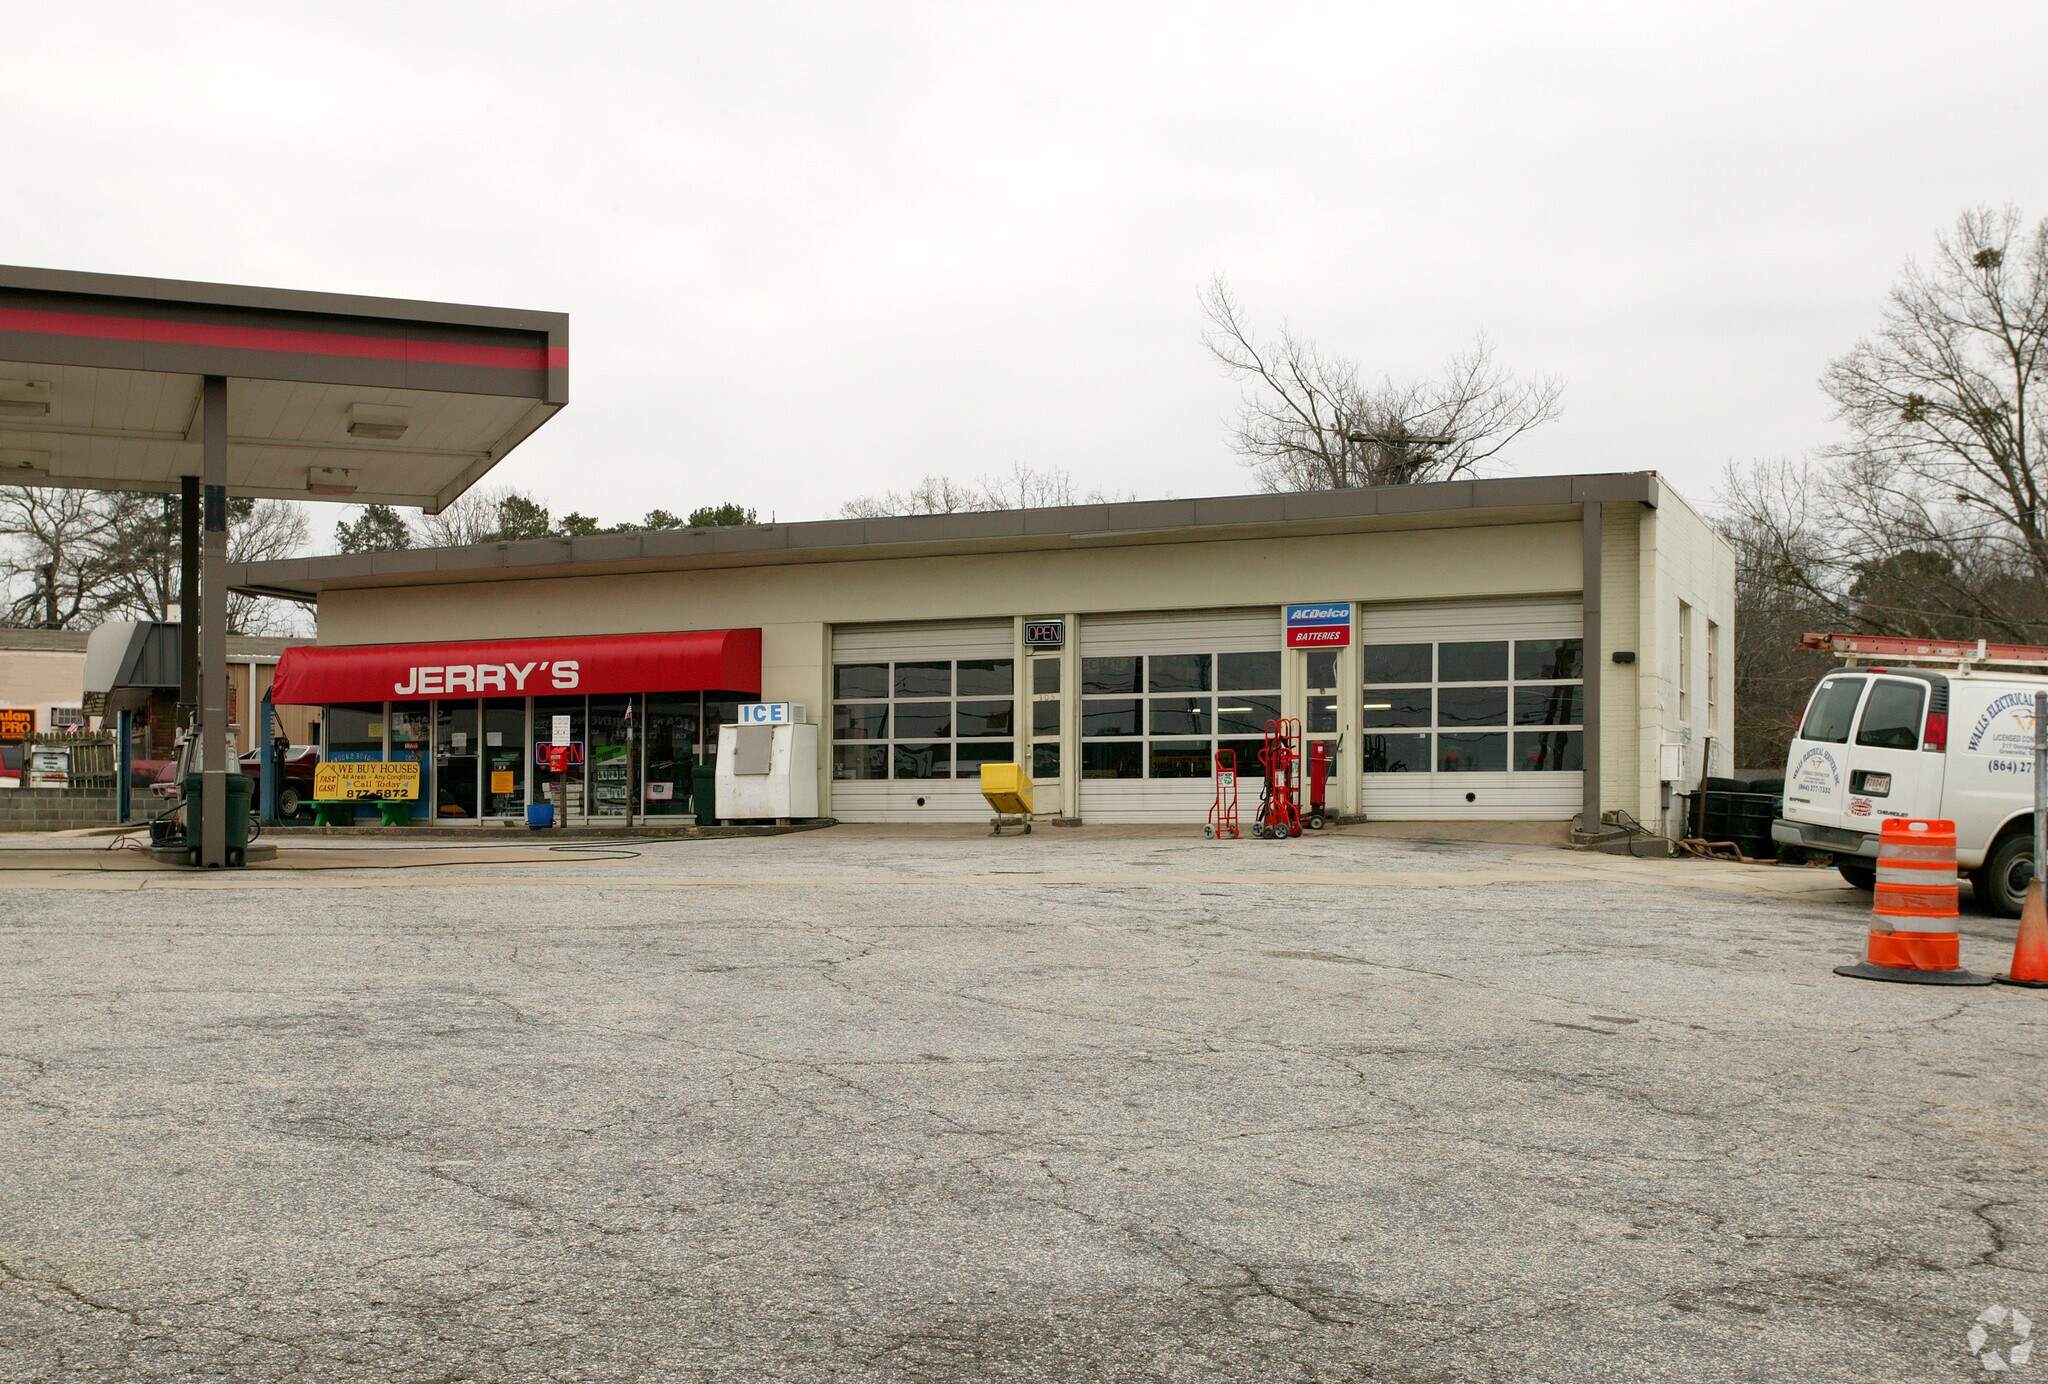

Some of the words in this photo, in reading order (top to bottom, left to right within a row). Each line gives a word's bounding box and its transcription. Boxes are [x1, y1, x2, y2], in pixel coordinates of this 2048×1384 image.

[1291, 608, 1349, 619] ACDelco
[1029, 626, 1059, 640] OPEN
[1296, 631, 1341, 641] BATTERIES
[394, 661, 579, 694] JERRY'S
[744, 705, 781, 722] ICE
[2, 721, 30, 733] PRO
[1968, 714, 1989, 751] WALLS
[1986, 692, 2034, 719] ELECTRICAL
[1993, 734, 2020, 742] LICENSED
[339, 764, 354, 774] WE
[357, 764, 377, 774] BUY
[380, 764, 418, 774] HOUSES
[1989, 760, 2017, 774] (864)
[320, 775, 336, 783] FAST
